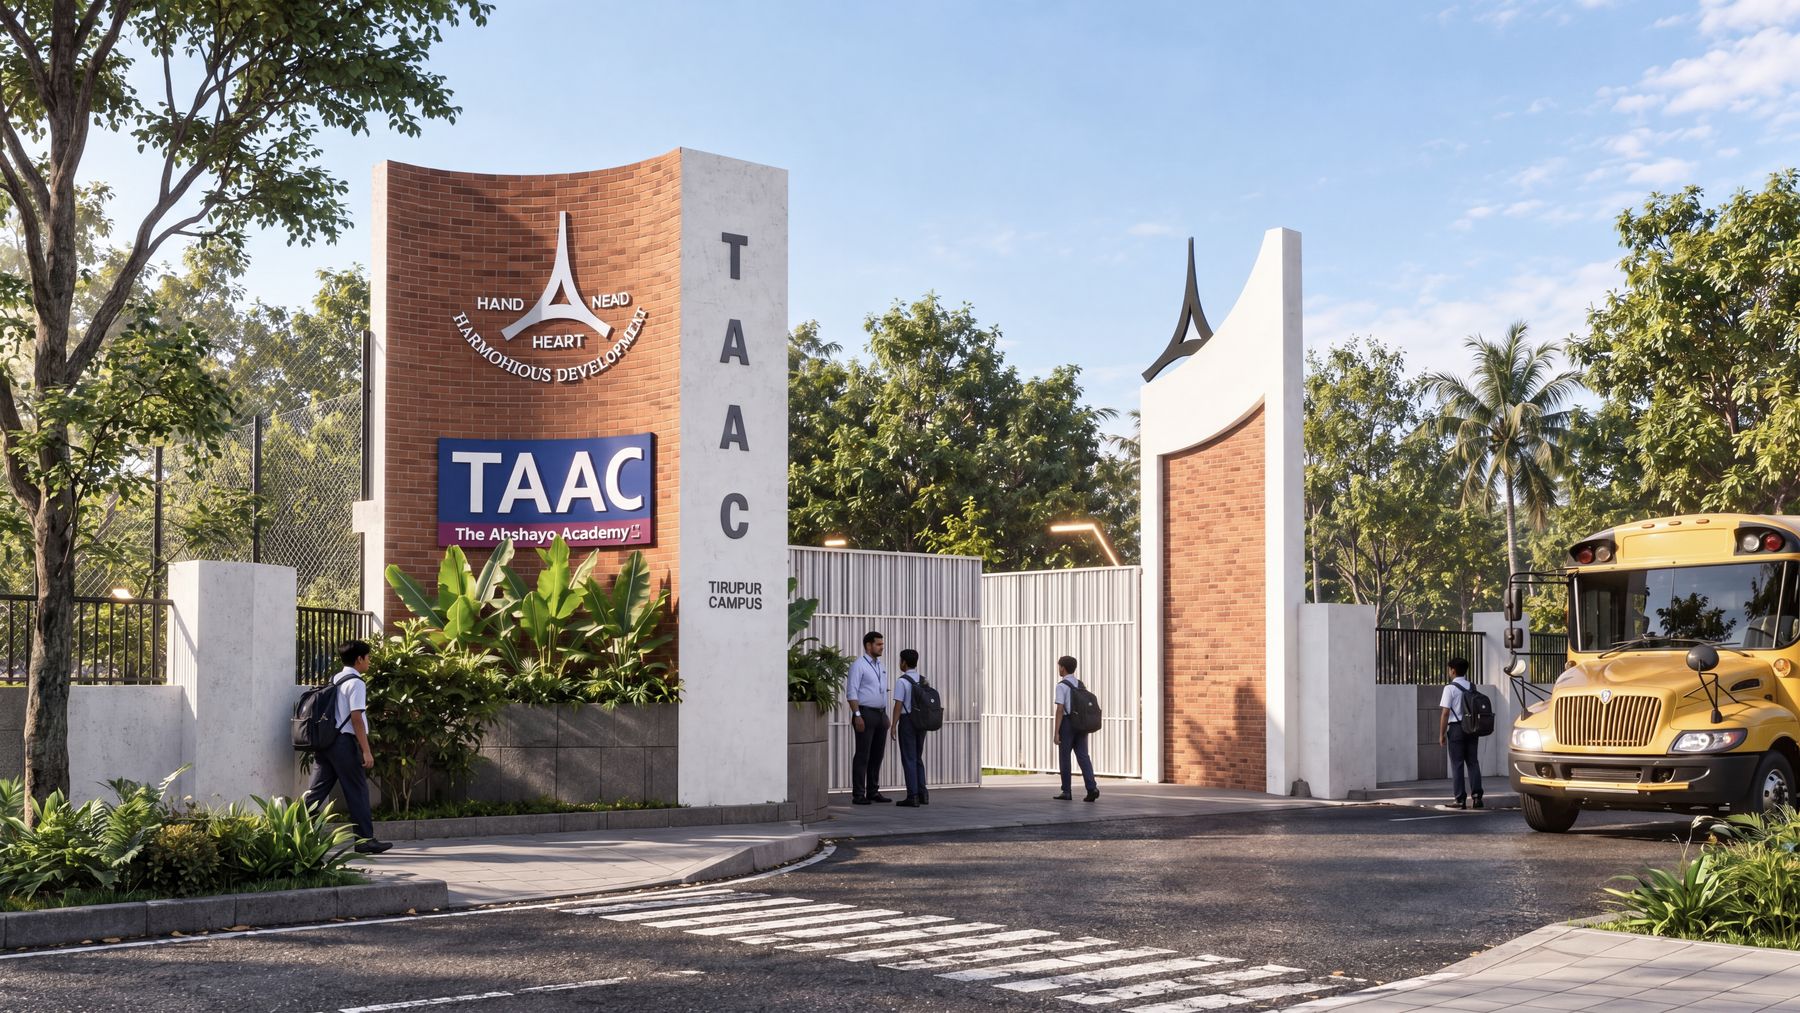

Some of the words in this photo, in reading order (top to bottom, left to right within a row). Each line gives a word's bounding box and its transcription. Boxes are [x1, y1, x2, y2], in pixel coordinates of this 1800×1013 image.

[477, 296, 524, 311] HAND
[591, 291, 630, 309] NEAD
[452, 311, 552, 382] HARMOHIOUS
[556, 306, 647, 382] DEVELOPMENT
[532, 334, 585, 349] HEART
[452, 447, 643, 513] TAAC
[455, 527, 485, 541] The
[562, 526, 630, 542] Academy
[708, 580, 762, 595] TIRUPUR
[708, 596, 762, 610] CAMPUS
